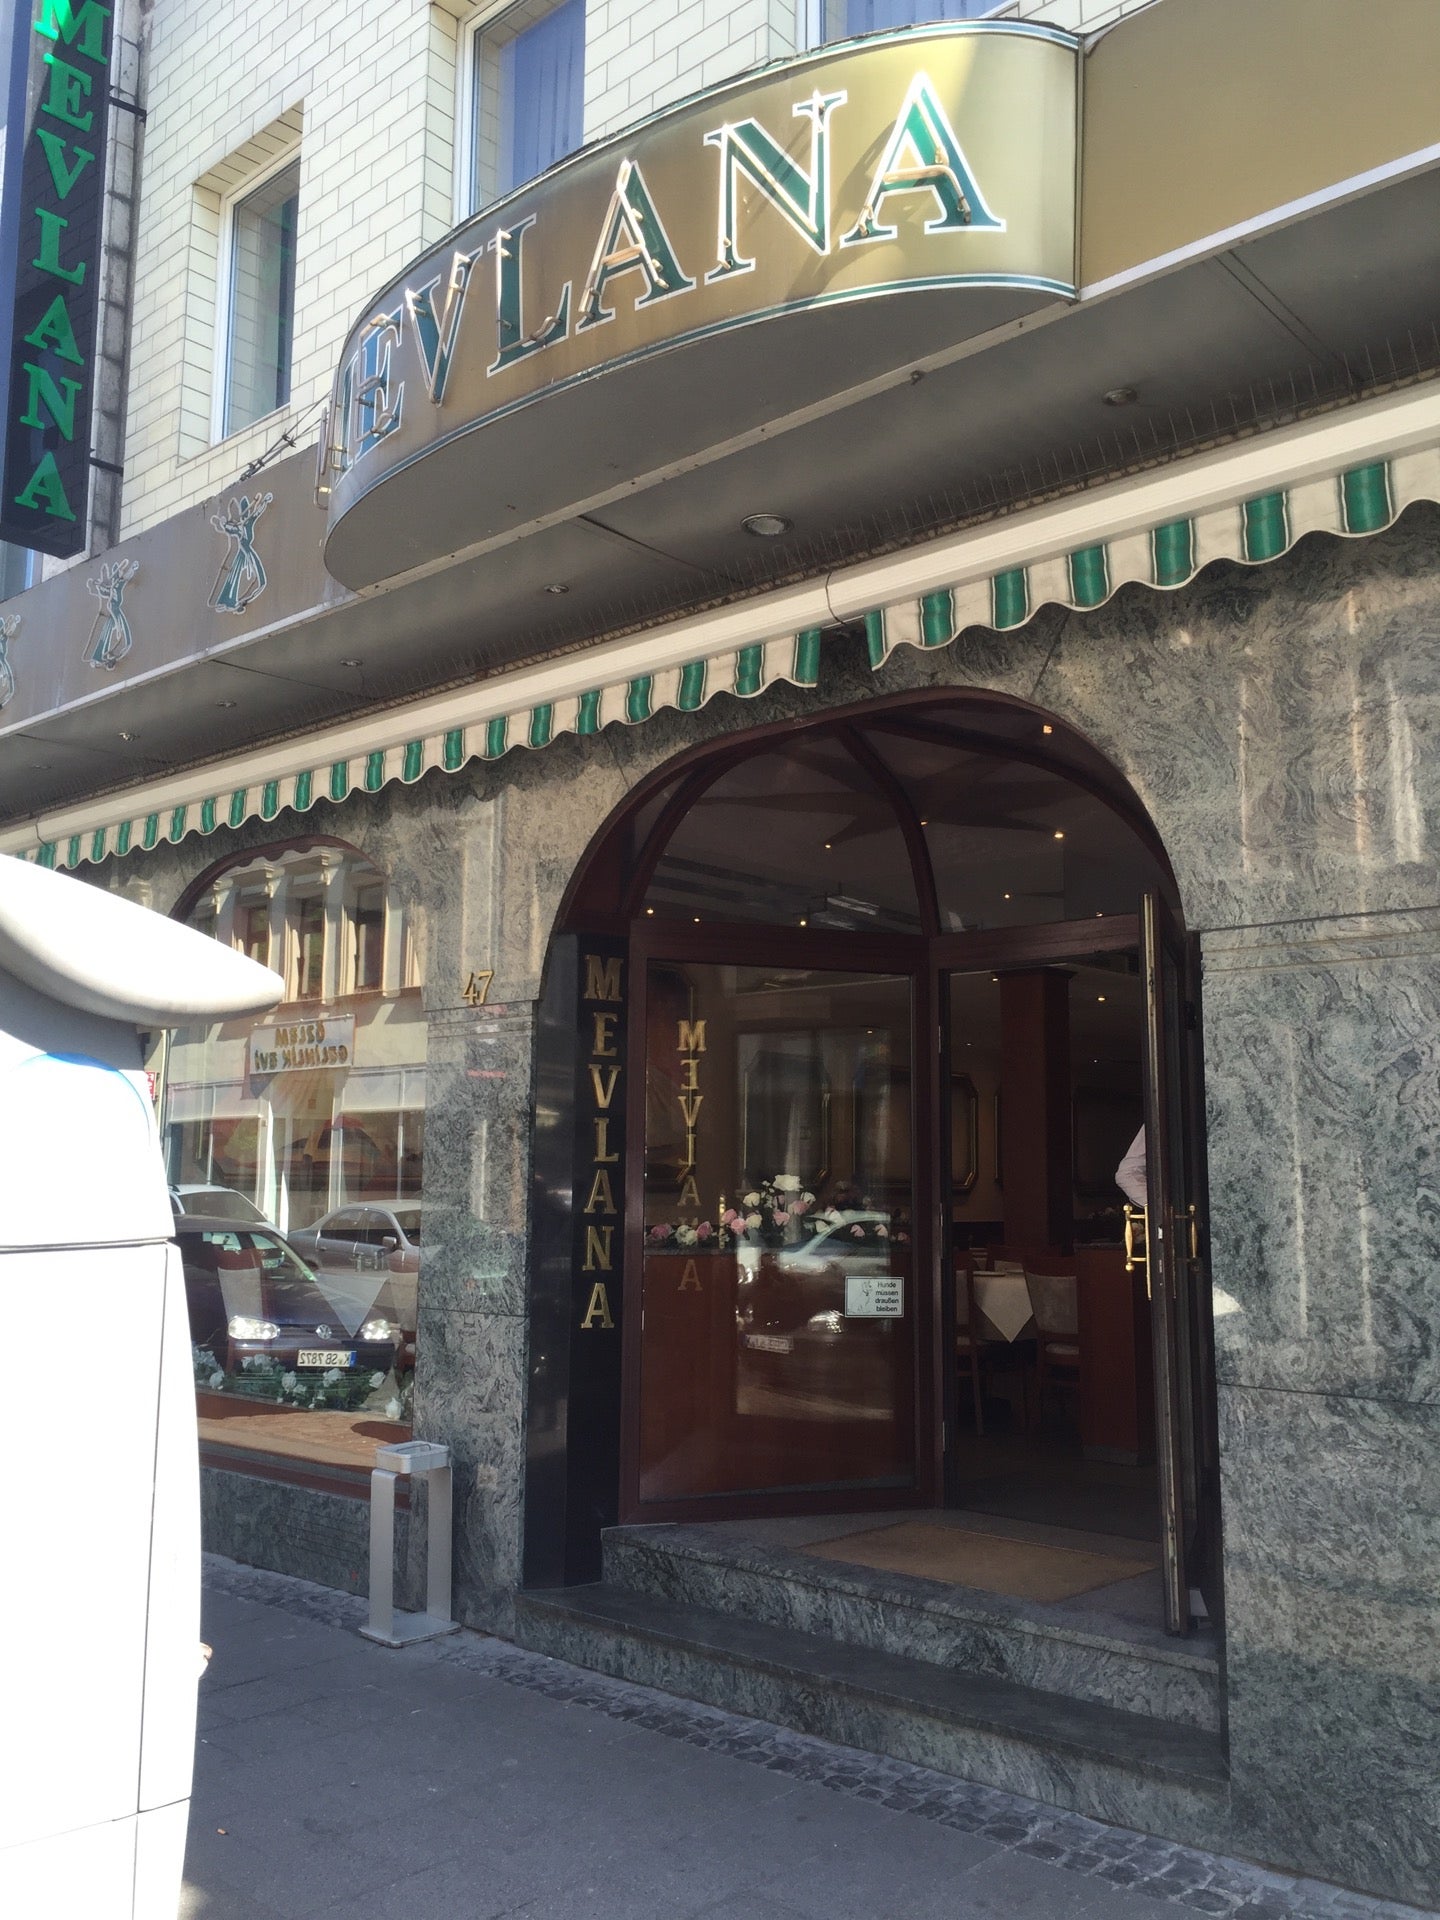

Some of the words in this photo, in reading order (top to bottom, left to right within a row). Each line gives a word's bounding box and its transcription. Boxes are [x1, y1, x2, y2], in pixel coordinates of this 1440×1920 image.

[14, 0, 109, 522] MEVLANA
[461, 968, 495, 1006] 47
[581, 954, 624, 1330] MEVLANA
